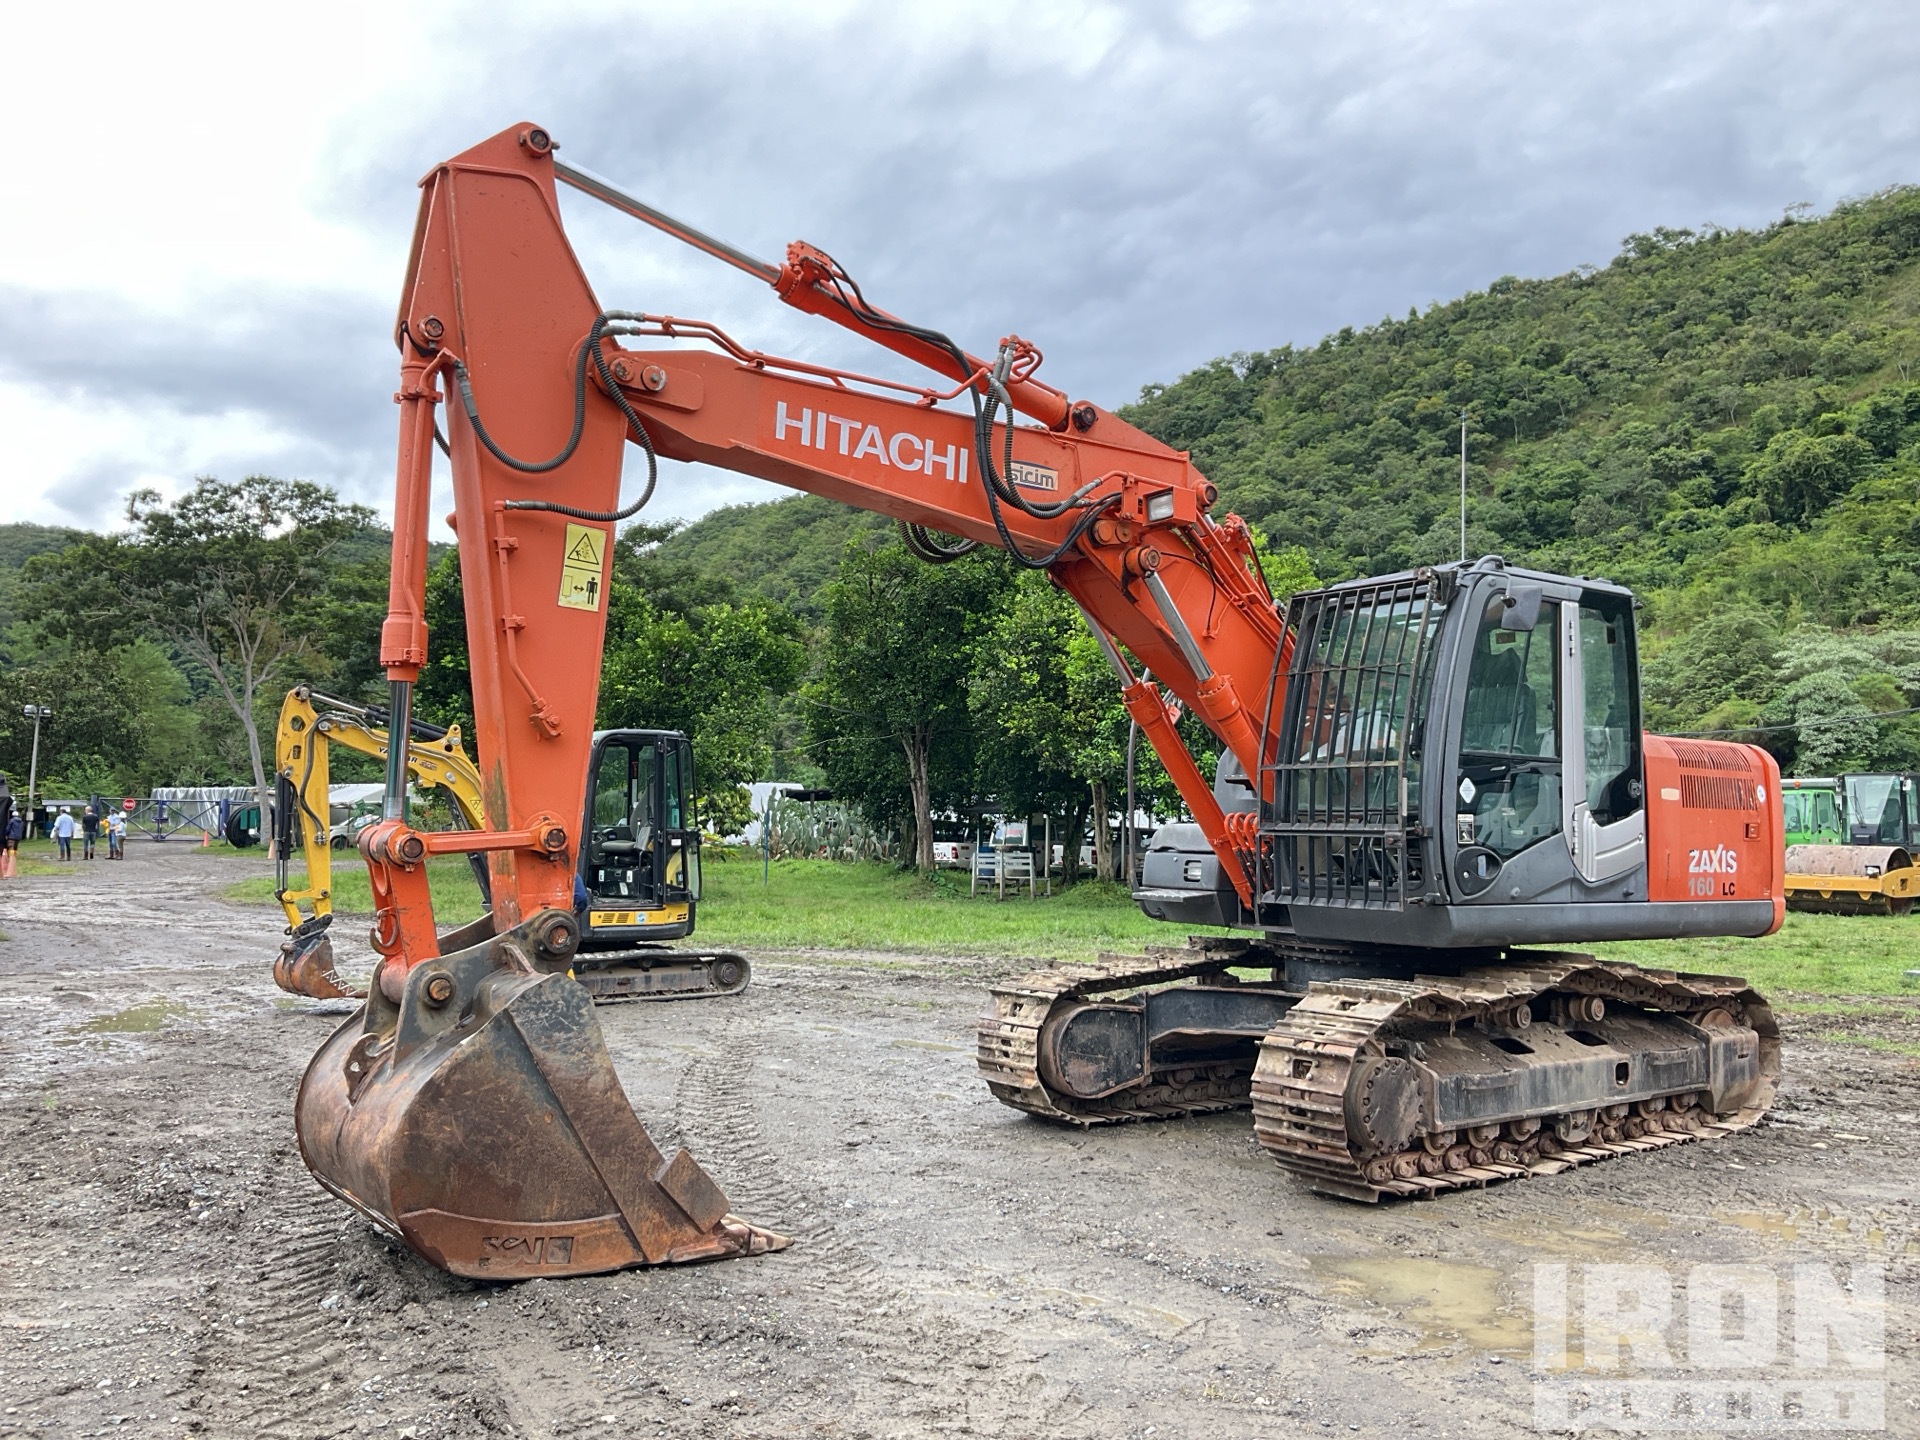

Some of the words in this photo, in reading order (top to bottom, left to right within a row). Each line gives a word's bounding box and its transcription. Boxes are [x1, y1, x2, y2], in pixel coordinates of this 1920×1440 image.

[775, 400, 969, 484] HITACHI
[1688, 843, 1738, 874] ZAXIS
[1688, 876, 1715, 897] 160
[1722, 882, 1736, 896] LC
